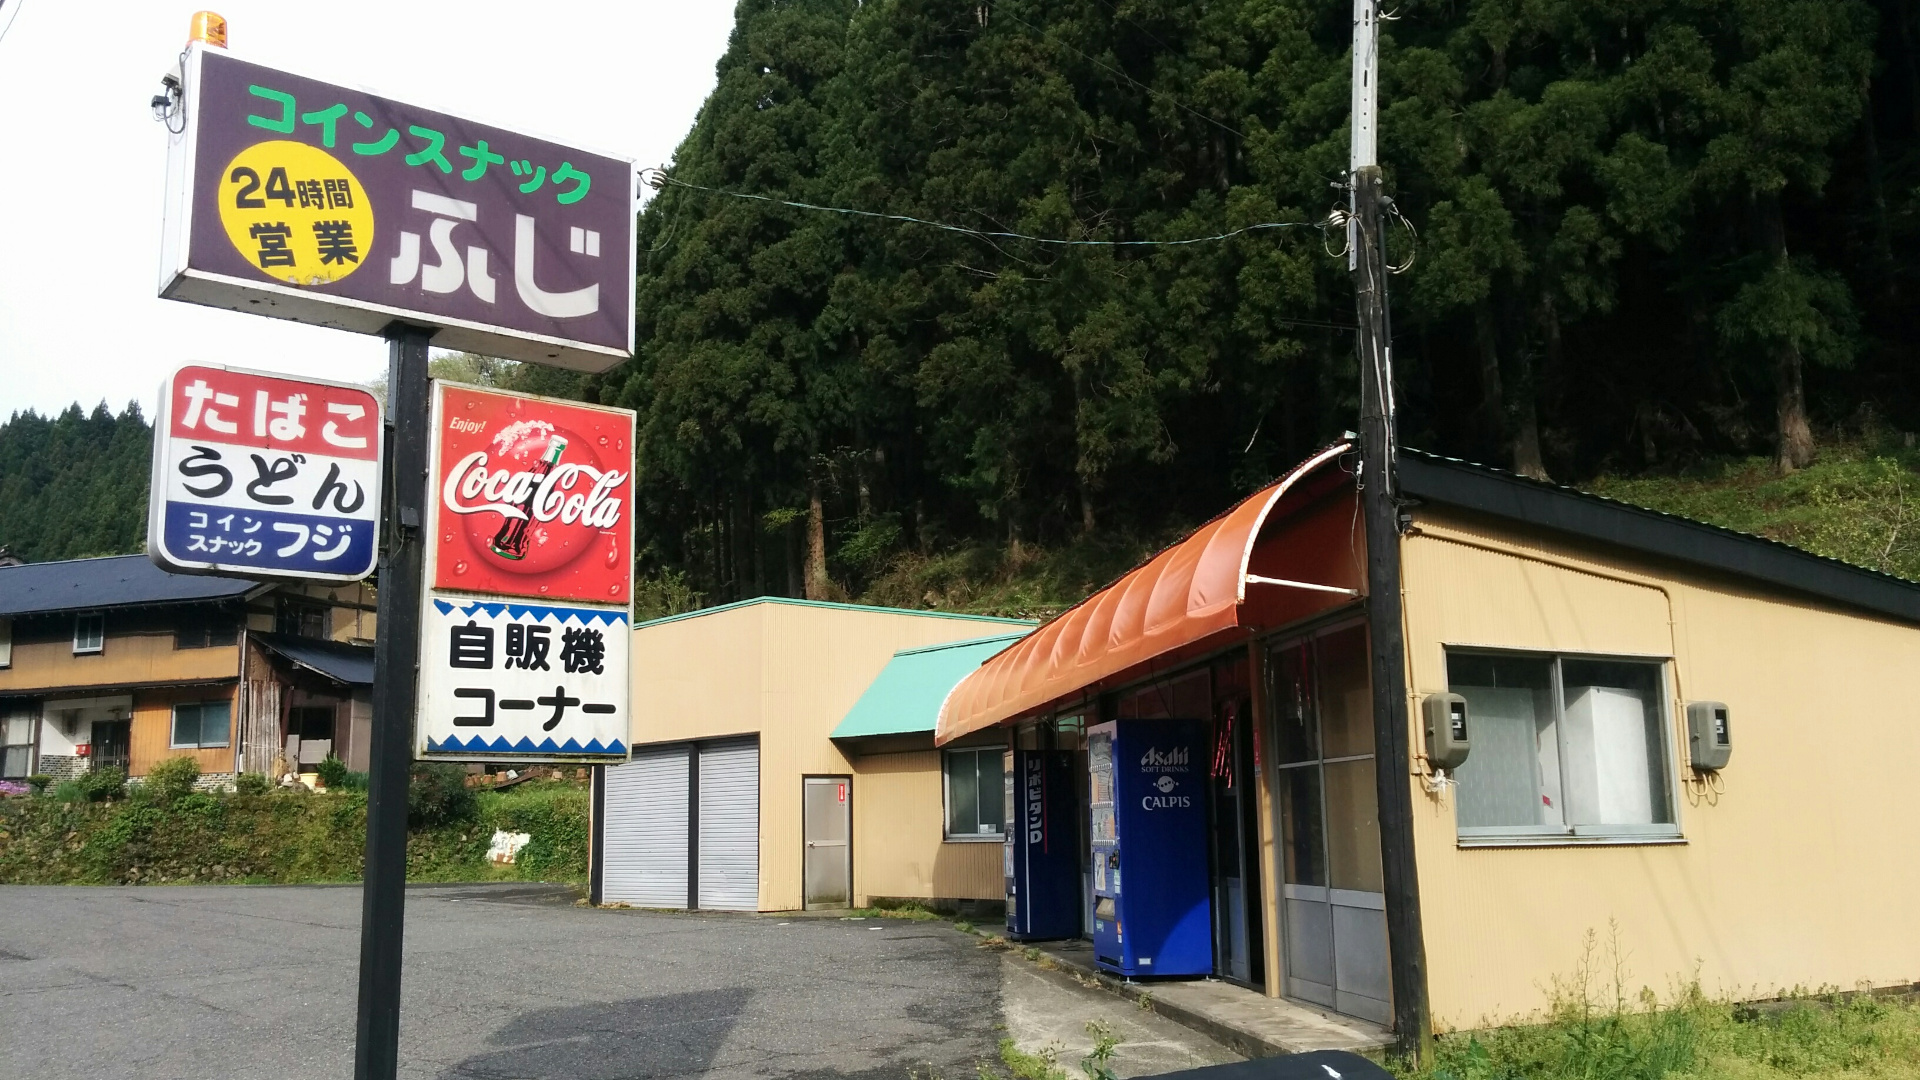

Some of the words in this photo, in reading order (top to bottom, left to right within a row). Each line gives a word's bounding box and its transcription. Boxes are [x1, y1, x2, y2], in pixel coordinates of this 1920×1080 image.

[247, 84, 592, 205] コインスナック
[230, 166, 355, 210] 24時間
[249, 219, 360, 268] 営業
[390, 189, 601, 319] ふじ
[182, 379, 369, 450] たばこ
[450, 417, 487, 434] Enjoy!
[178, 445, 366, 514] うどん
[443, 451, 629, 529] Coca-Cola
[186, 534, 263, 557] スナック
[189, 511, 263, 534] コイン
[272, 521, 353, 562] フジ
[449, 620, 606, 676] 自販機
[453, 685, 617, 732] コーナー
[1140, 746, 1189, 766] Asahi
[1142, 796, 1191, 811] CALPIS
